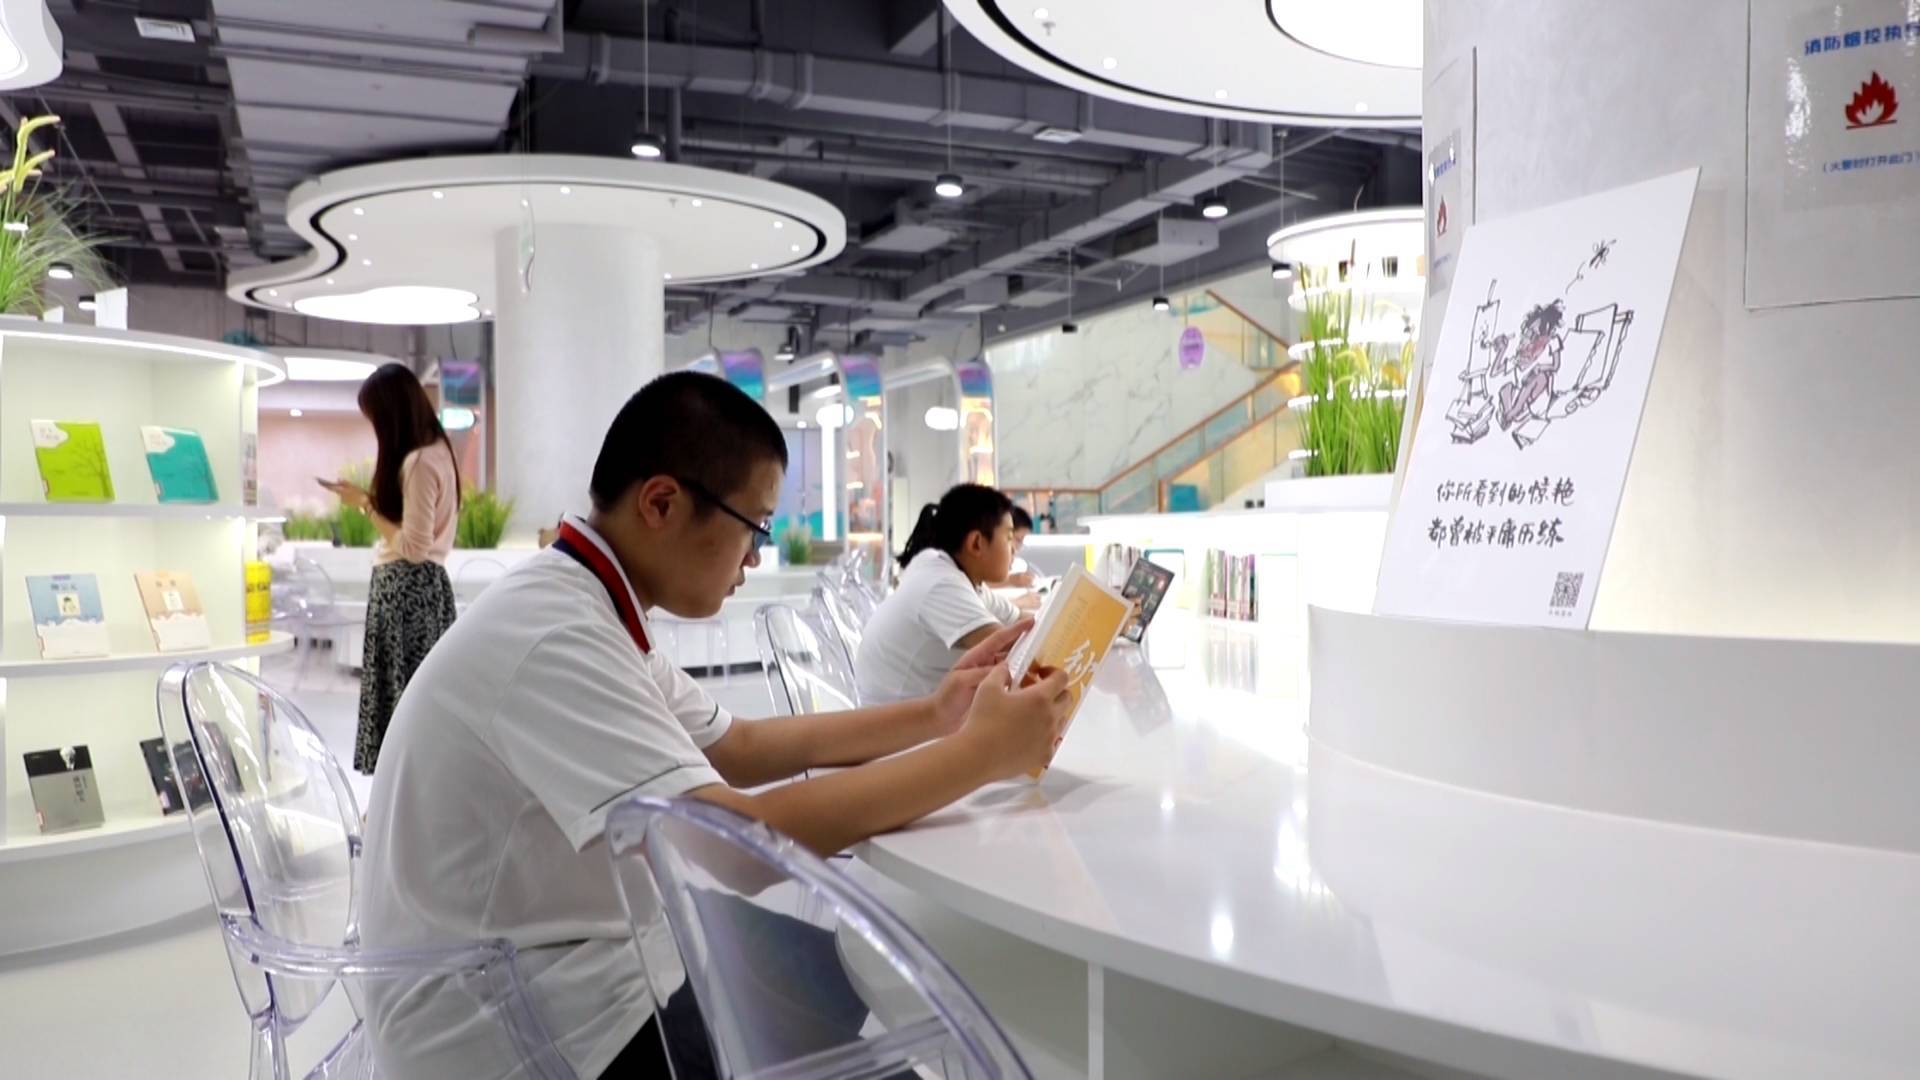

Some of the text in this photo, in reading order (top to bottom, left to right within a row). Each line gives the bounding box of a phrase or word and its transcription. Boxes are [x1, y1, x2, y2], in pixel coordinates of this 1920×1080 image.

[1437, 476, 1575, 507] 你所看到的惊艳
[1428, 515, 1564, 548] 都曾被平庸历练
